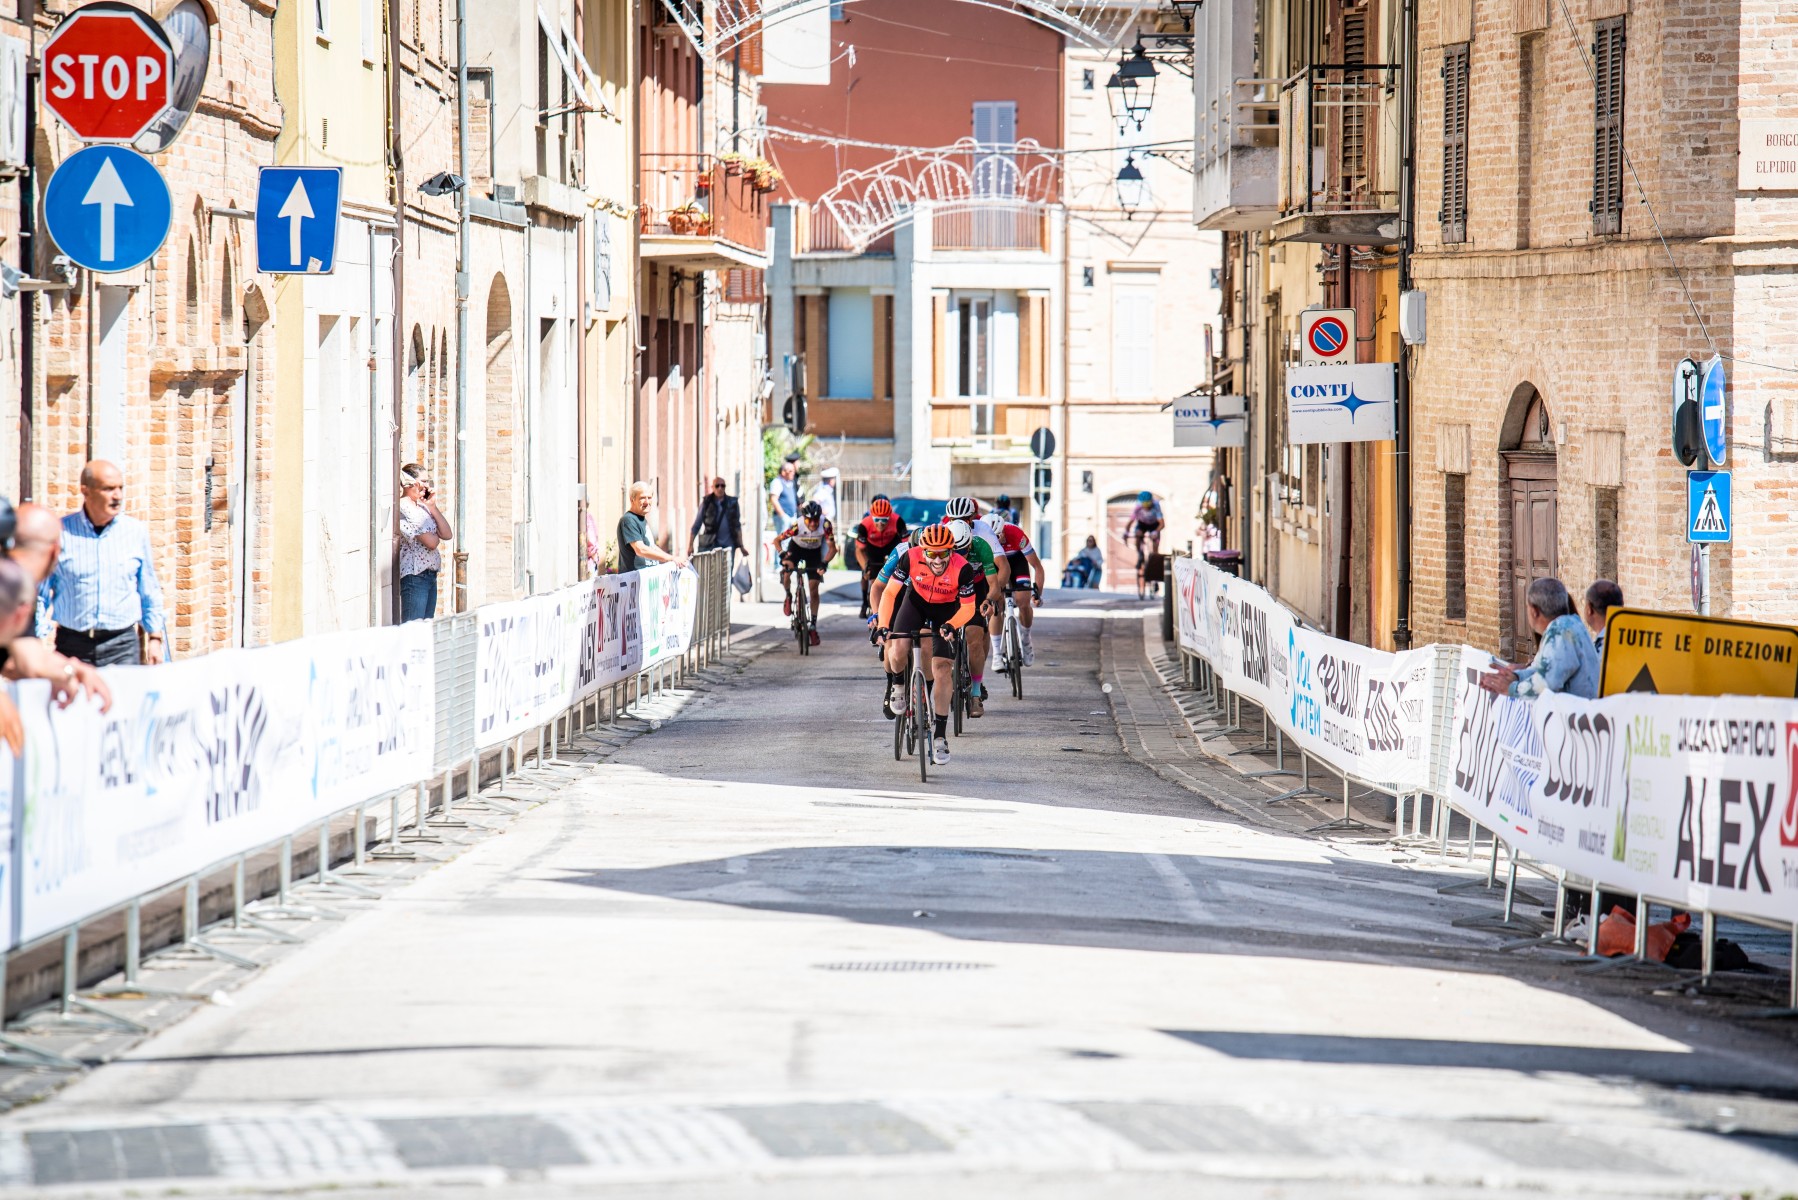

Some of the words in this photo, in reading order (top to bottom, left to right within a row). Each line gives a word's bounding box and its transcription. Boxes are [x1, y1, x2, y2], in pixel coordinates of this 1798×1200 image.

[51, 54, 162, 101] STOP
[1766, 133, 1798, 147] BORGO
[1756, 160, 1796, 173] ELPIDIO
[1290, 383, 1348, 399] CONTI
[1174, 408, 1212, 418] CONT
[1617, 627, 1663, 650] TUTTE
[1674, 633, 1692, 653] LE
[1703, 637, 1793, 664] DIREZIONI
[1678, 717, 1776, 758] CALZATURIFICIO
[1673, 776, 1776, 894] ALEX
